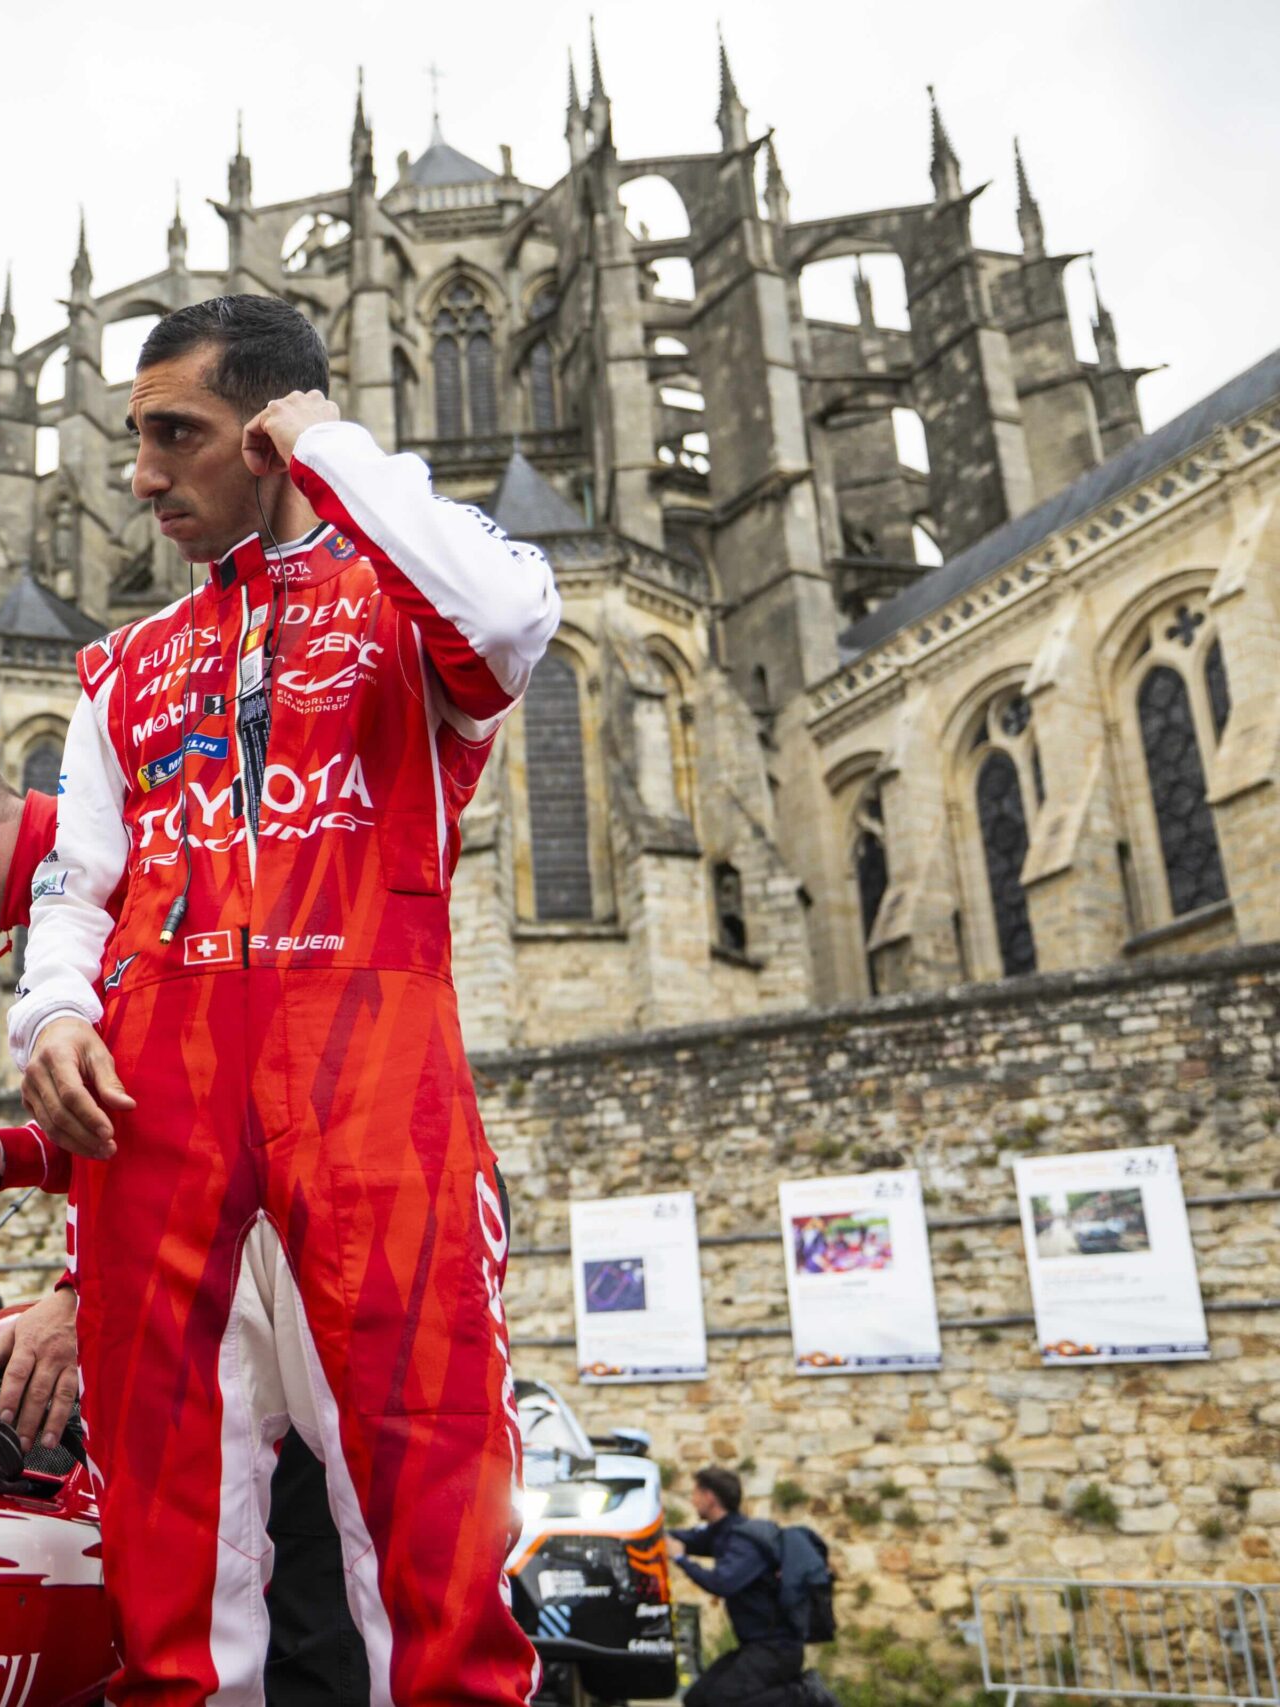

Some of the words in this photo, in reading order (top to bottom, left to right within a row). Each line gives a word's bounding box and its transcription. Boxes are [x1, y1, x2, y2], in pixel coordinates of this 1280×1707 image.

[268, 561, 312, 577] YOTA
[306, 632, 366, 659] ZEN
[277, 689, 293, 701] FIA
[295, 695, 333, 707] WORLD
[248, 934, 271, 950] S.
[275, 934, 345, 950] BUEMI
